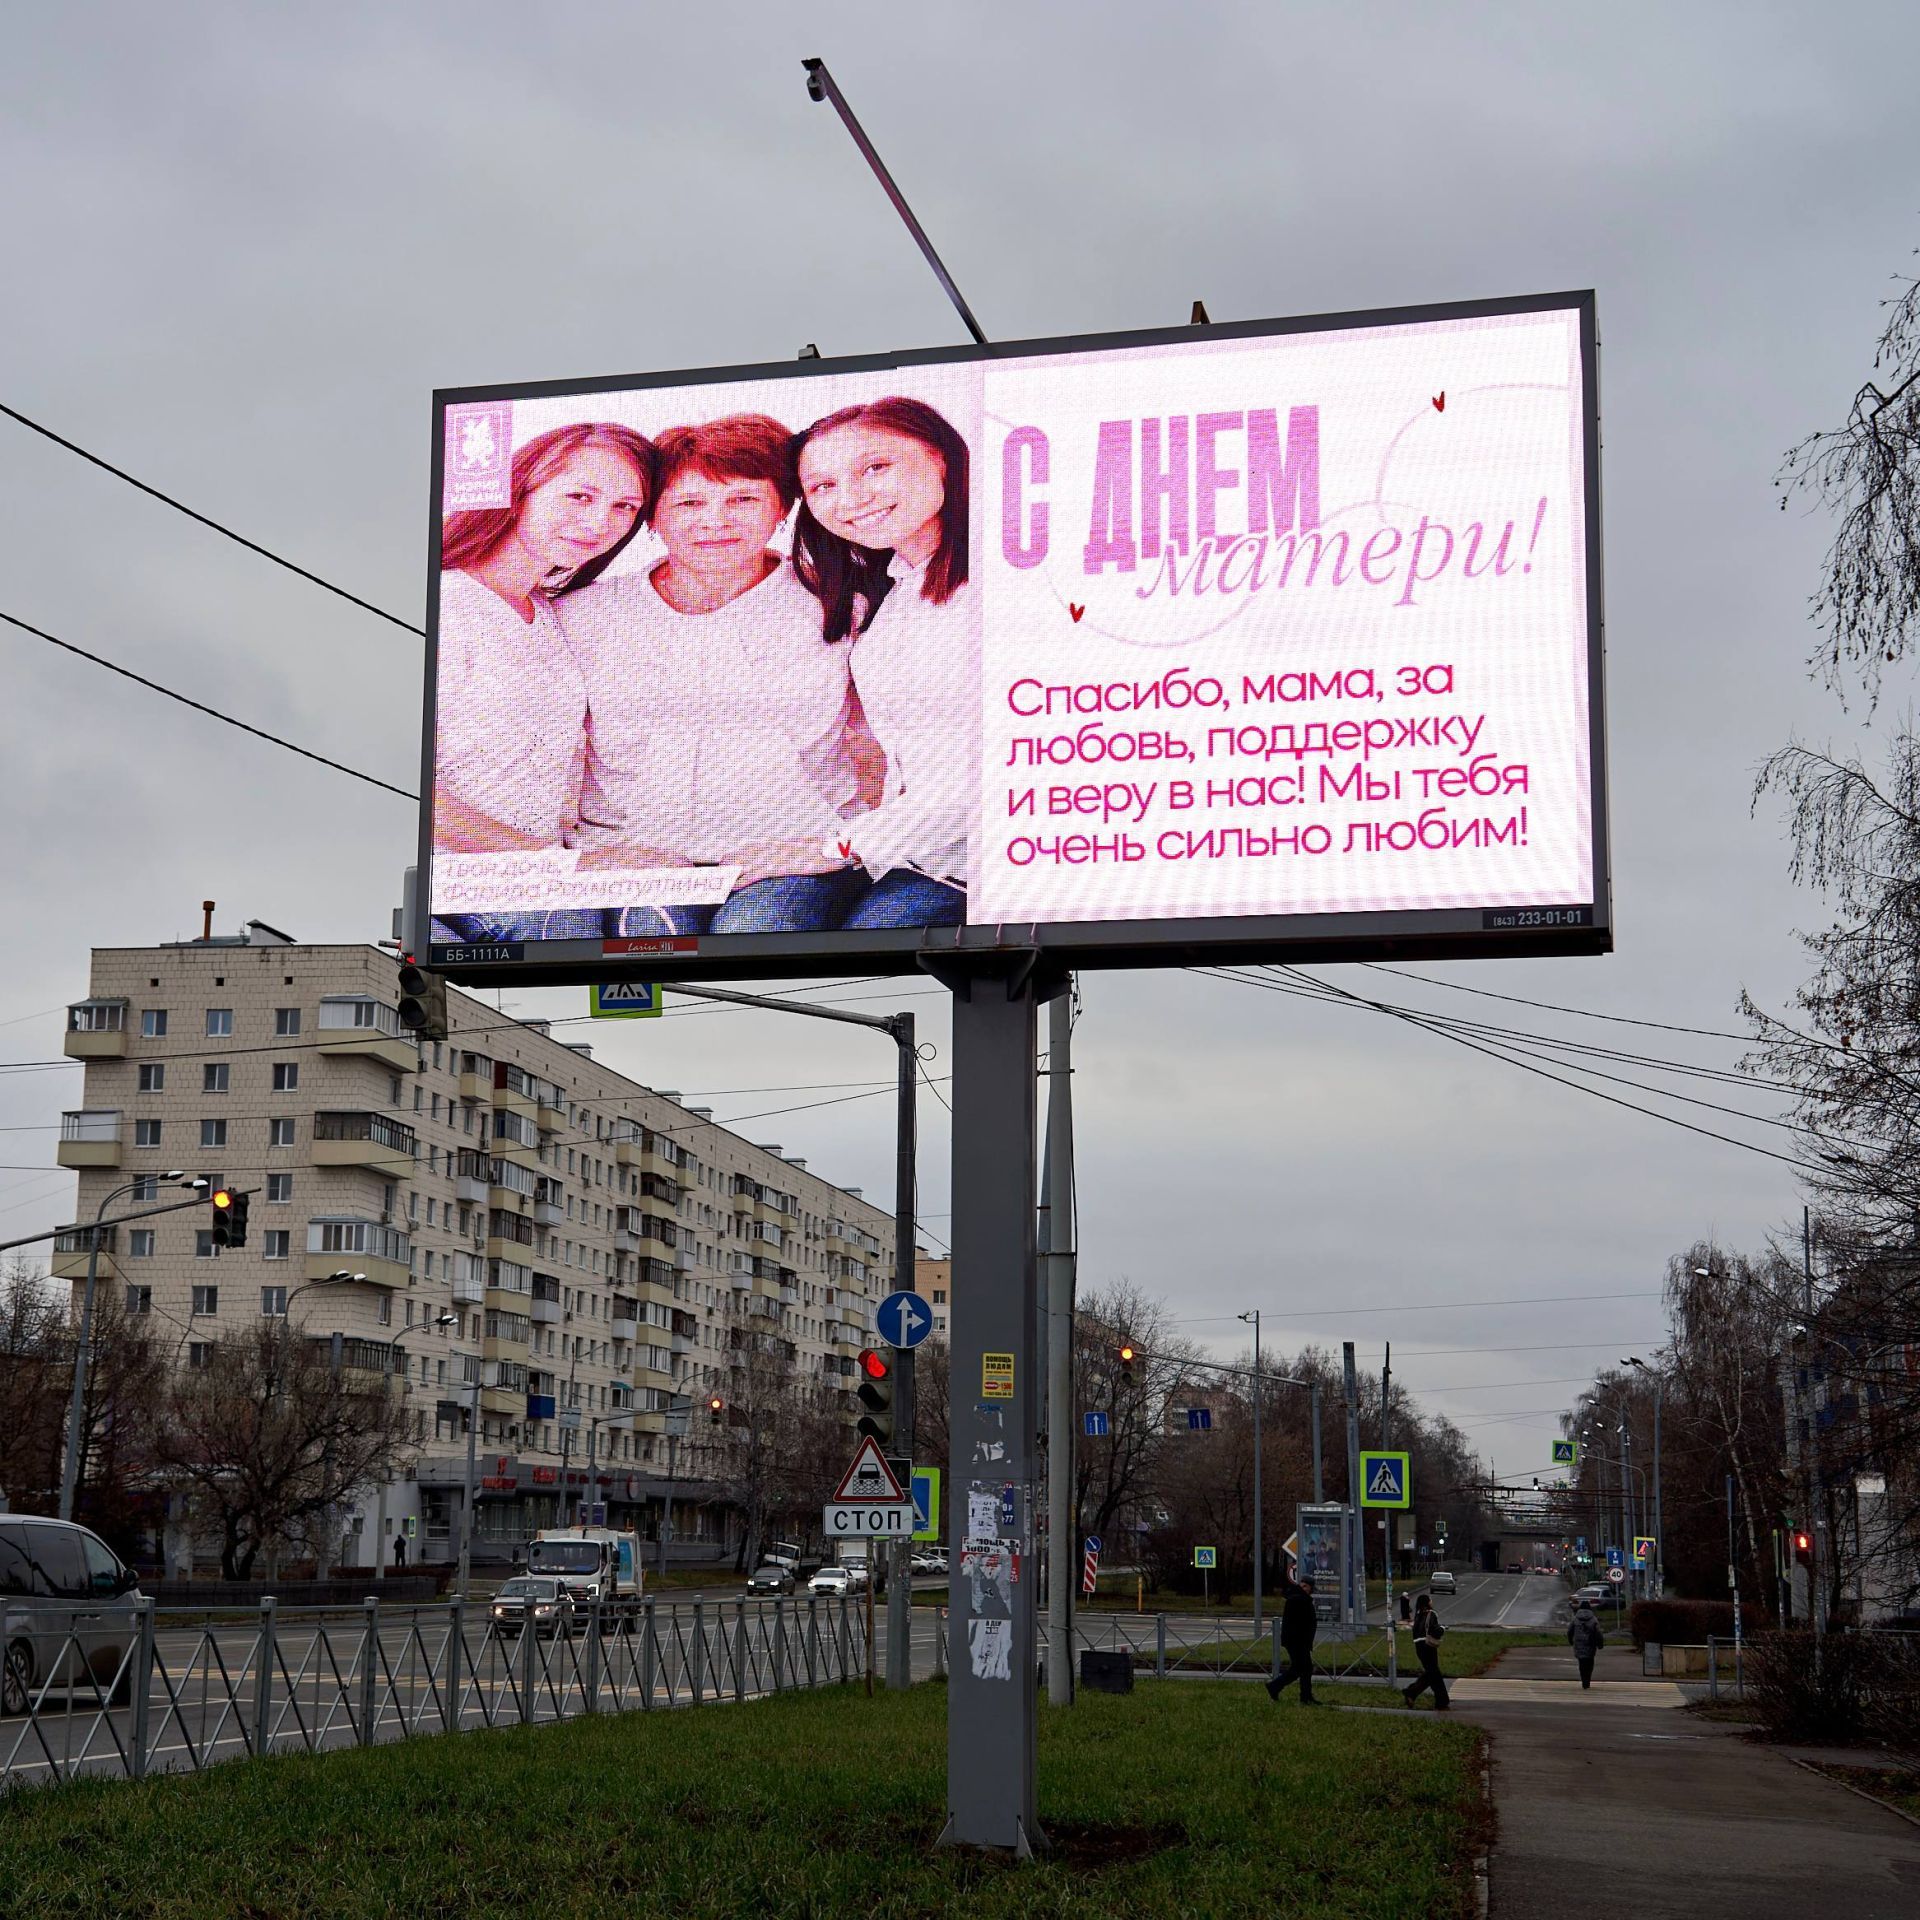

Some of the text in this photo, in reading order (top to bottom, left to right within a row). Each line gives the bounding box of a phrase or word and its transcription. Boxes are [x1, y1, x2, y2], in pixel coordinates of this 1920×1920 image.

[1002, 406, 1321, 575] С ДНЕМ
[1134, 496, 1548, 606] матери!
[1007, 663, 1454, 716] Спасибо, мама, за
[1006, 715, 1487, 767] любовь, поддержку
[1008, 752, 1530, 824] и веру в нас! Мы тебя
[1006, 806, 1529, 866] очень сильно любим!
[1493, 910, 1582, 927] (843) 233-01-01
[445, 947, 511, 961] ББ-1111А
[627, 942, 658, 952] Larisa
[834, 1510, 902, 1531] СТОП
